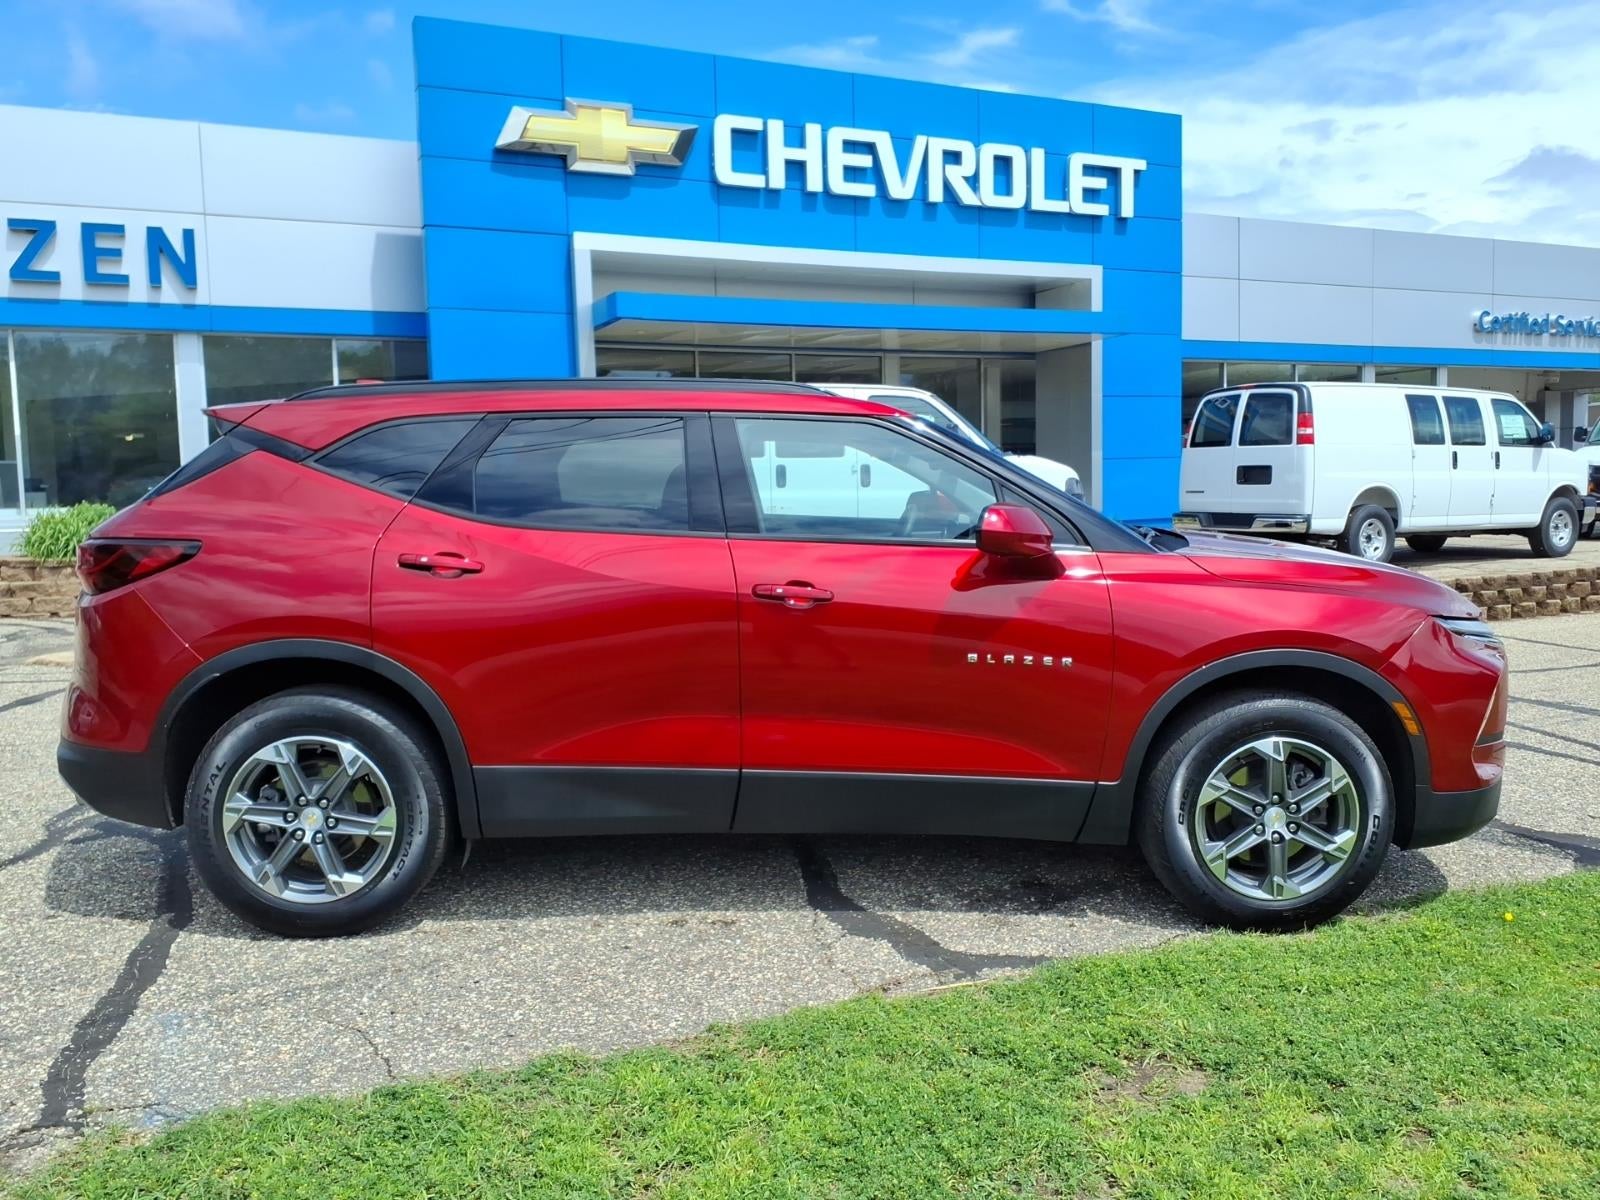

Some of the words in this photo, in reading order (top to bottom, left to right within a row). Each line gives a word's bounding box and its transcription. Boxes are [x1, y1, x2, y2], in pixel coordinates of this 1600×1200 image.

[713, 113, 1147, 219] CHEVROLET
[7, 217, 198, 290] ZEN
[1475, 310, 1550, 334] Certified
[967, 653, 1073, 667] BLAZER
